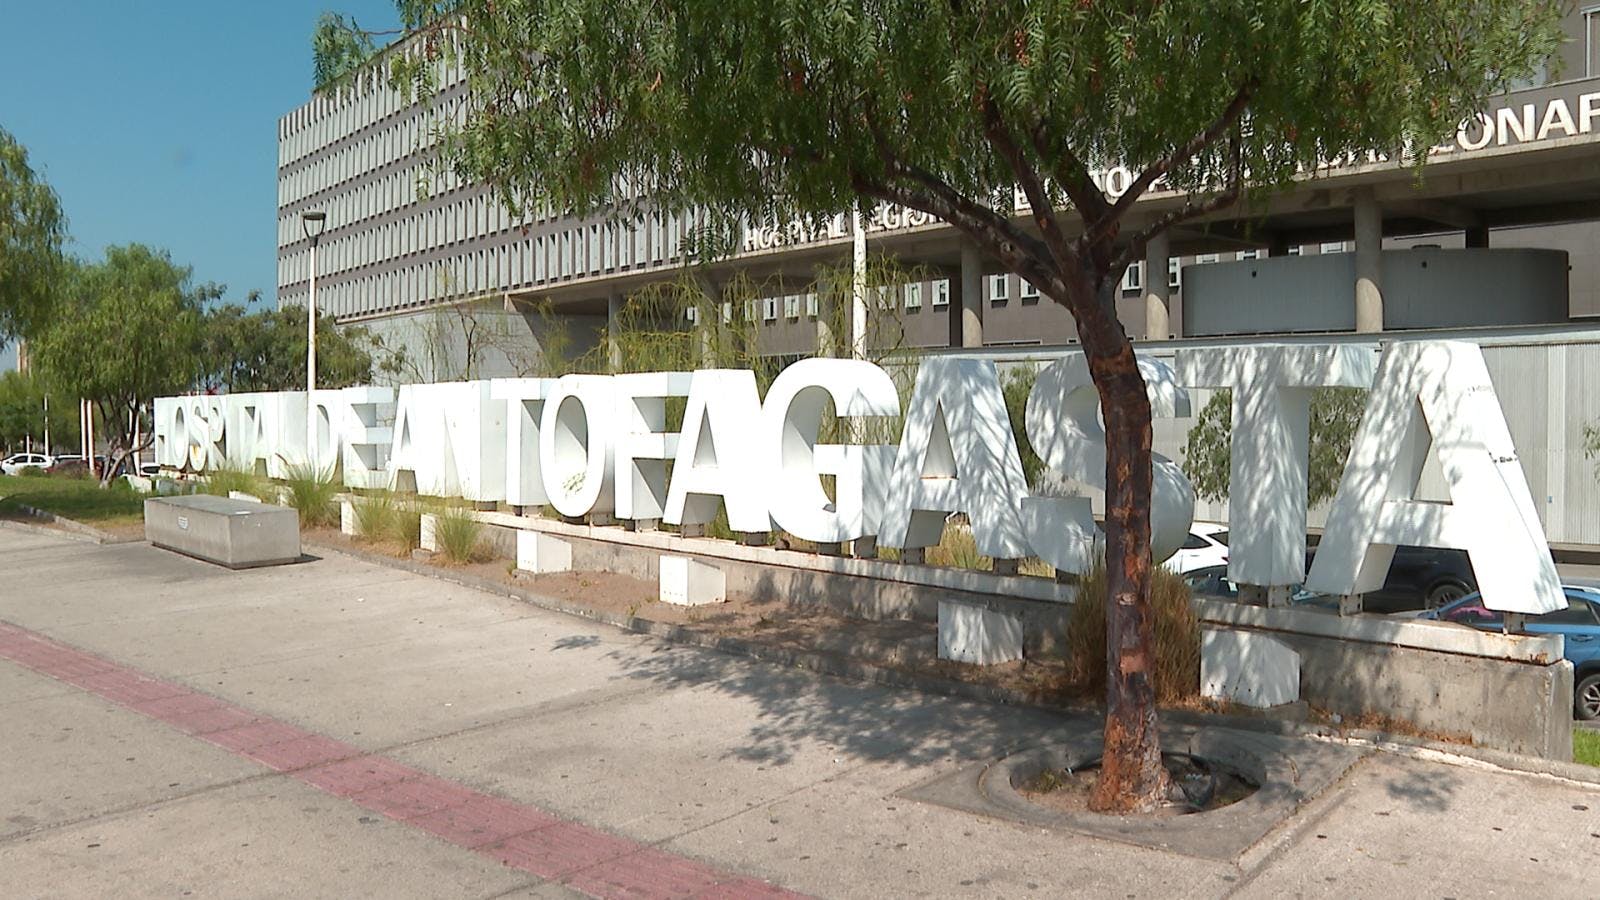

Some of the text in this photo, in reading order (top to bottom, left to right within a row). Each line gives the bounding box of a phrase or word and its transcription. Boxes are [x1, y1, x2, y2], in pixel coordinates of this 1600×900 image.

[154, 338, 1568, 615] HOSPITAL DE ANTOFAGASTA
